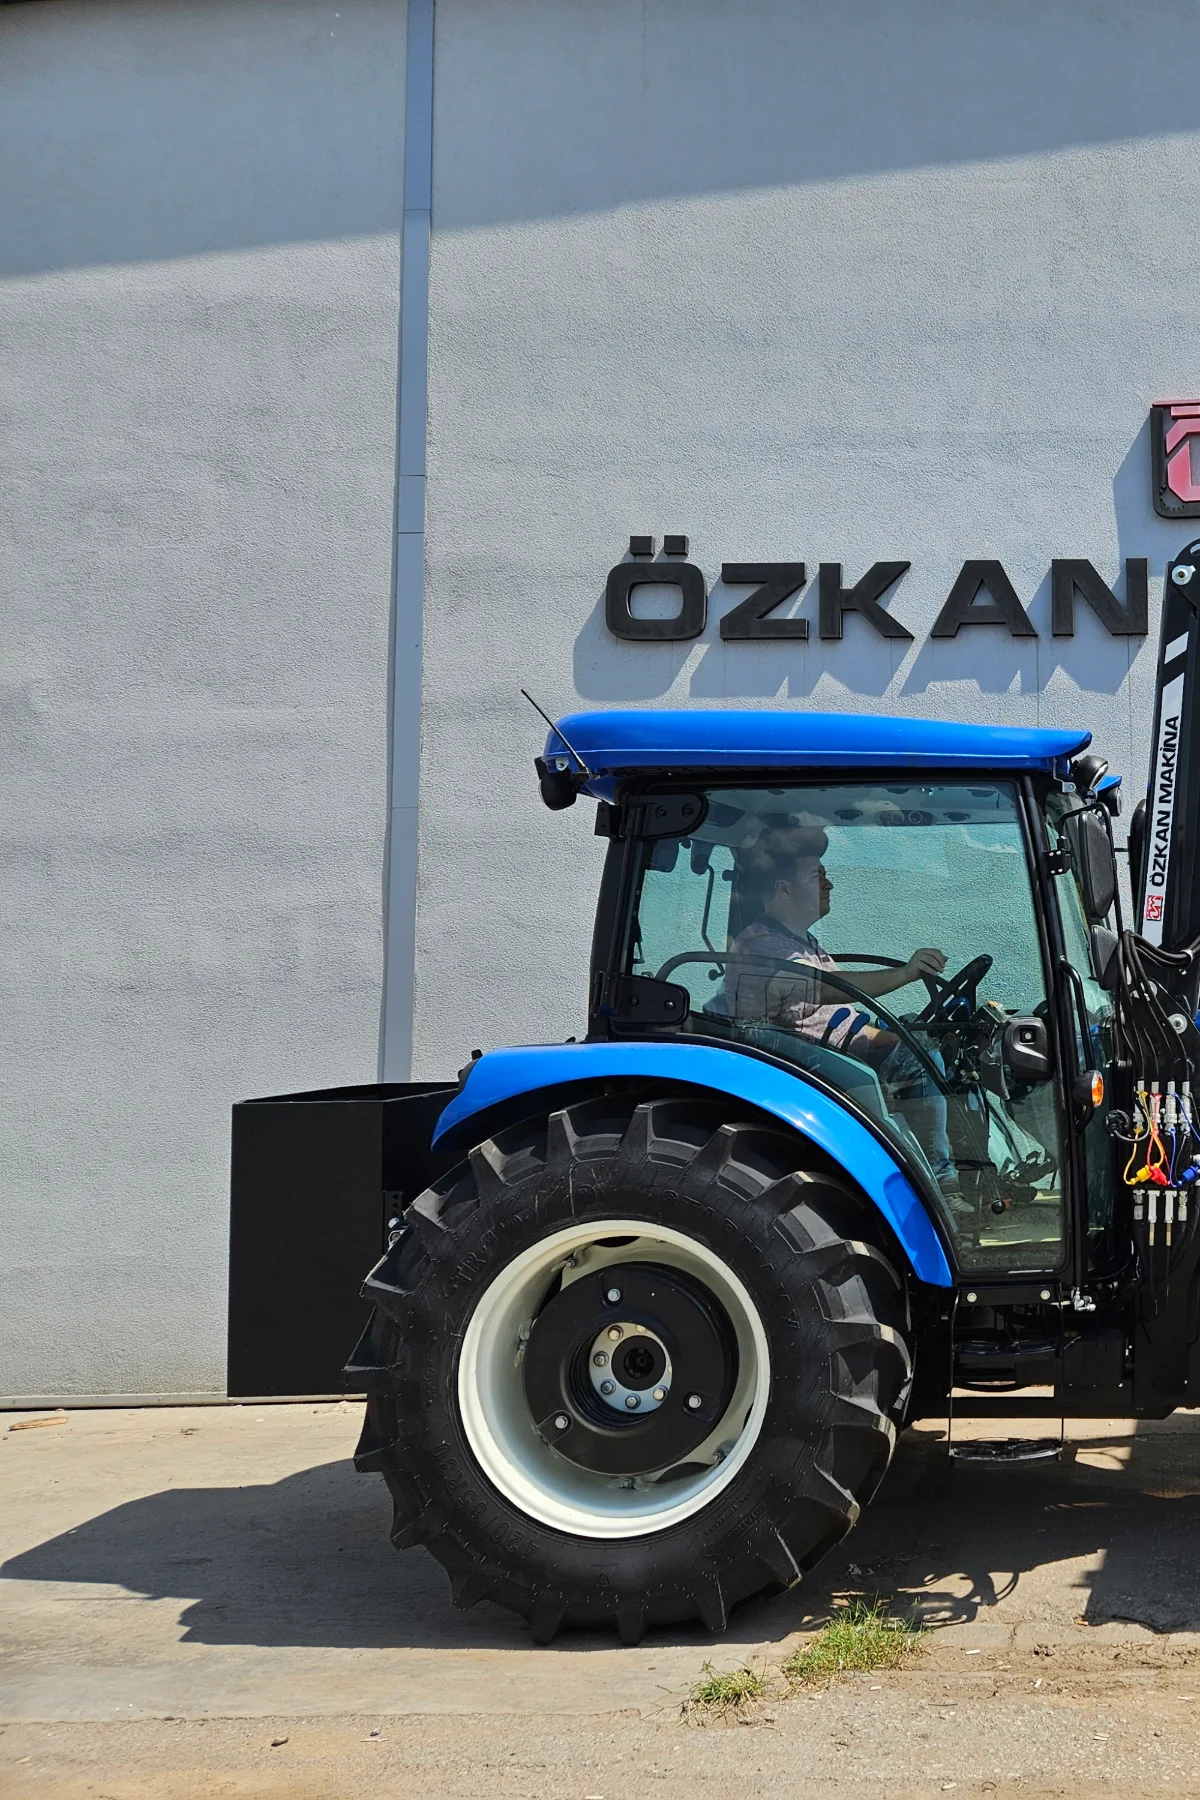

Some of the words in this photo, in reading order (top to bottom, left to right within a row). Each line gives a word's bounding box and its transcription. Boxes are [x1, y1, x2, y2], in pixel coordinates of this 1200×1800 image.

[605, 535, 1149, 641] ÖZKAN
[1158, 714, 1180, 804] MAKİNA
[1149, 810, 1172, 887] ÖZKAN
